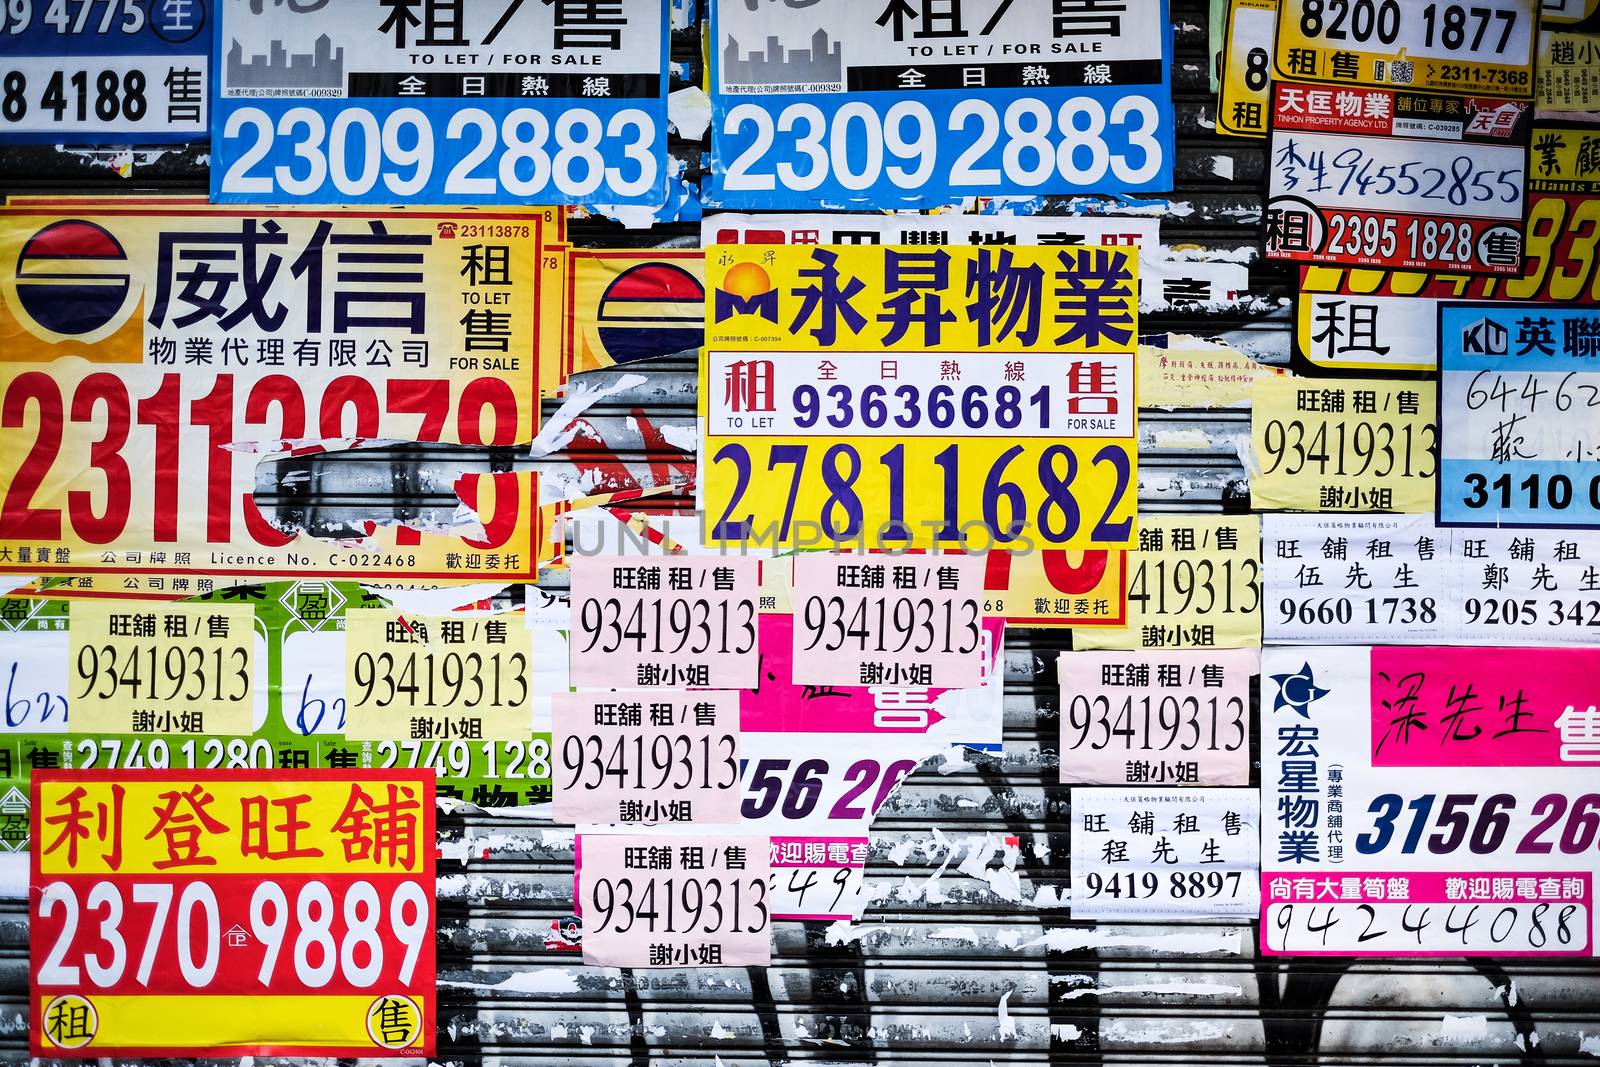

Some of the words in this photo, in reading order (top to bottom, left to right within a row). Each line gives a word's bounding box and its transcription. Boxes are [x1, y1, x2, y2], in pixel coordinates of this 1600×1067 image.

[45, 0, 146, 34] 4775
[1300, 0, 1400, 45] 8200
[1423, 4, 1517, 54] 1877
[409, 54, 434, 66] TO
[444, 54, 480, 66] LET
[503, 54, 542, 66] FOR
[551, 54, 603, 66] SALE
[907, 46, 934, 58] TO
[944, 45, 977, 57] LET
[1002, 43, 1041, 55] FOR
[1051, 42, 1103, 55] SALE
[1288, 48, 1317, 76] 租
[1331, 51, 1360, 79] 售
[398, 75, 611, 97] 全日熱線
[897, 64, 1113, 89] 全日熱線
[1440, 65, 1529, 85] 2311-7368
[41, 69, 147, 122] 4188
[163, 66, 202, 124] 售
[1397, 97, 1461, 115] 舖位專家
[1232, 101, 1262, 129] 租
[1278, 115, 1302, 123] TINHON
[1303, 116, 1342, 126] PROPERTY
[1343, 119, 1373, 128] AGENCY
[221, 107, 434, 196] 2309
[444, 107, 658, 197] 2883
[722, 100, 938, 192] 2309
[949, 95, 1164, 186] 2883
[461, 225, 530, 241] 23113878
[1328, 213, 1398, 257] 2395
[1405, 218, 1473, 263] 1828
[1482, 231, 1520, 265] 售
[148, 218, 433, 334] 威信
[460, 243, 513, 286] 租
[462, 292, 480, 305] TO
[485, 292, 511, 305] LET
[788, 248, 1134, 348] 永昇物業
[460, 309, 513, 353] 售
[1311, 300, 1391, 359] 租
[1515, 316, 1600, 358] 英聯
[148, 337, 429, 367] 物業代理有限公司
[449, 358, 479, 371] FOR
[482, 358, 520, 371] SALE
[818, 360, 1024, 382] 全日熱線
[723, 359, 778, 413] 租
[1066, 361, 1119, 415] 售
[793, 384, 1051, 429] 93636681
[1297, 389, 1345, 413] 旺舖
[727, 417, 743, 429] TO
[751, 417, 774, 429] LET
[1067, 419, 1088, 430] FOR
[1090, 419, 1116, 430] SALE
[1264, 419, 1437, 478] 93419313
[711, 442, 1133, 543] 27811682
[1319, 486, 1393, 509] 謝小姐
[1463, 473, 1574, 510] 3110
[0, 545, 71, 565] 大量實盤
[101, 550, 193, 566] 公司牌照
[210, 551, 276, 566] Licence
[287, 554, 317, 567] No.
[329, 553, 417, 567] C-022468
[445, 552, 521, 570] 歡迎委托
[1277, 536, 1435, 562] 旺舖租售
[1463, 537, 1582, 563] 旺舖租
[614, 566, 661, 591] 旺舖
[837, 565, 885, 590] 旺舖
[1294, 562, 1420, 590] 伍先生
[1481, 563, 1600, 593] 鄭先生
[1034, 597, 1109, 616] 歡迎委托
[1279, 597, 1353, 625] 9660
[1364, 597, 1438, 625] 1738
[1464, 598, 1539, 626] 9205
[109, 613, 158, 638] 旺舖
[581, 597, 756, 655] 93419313
[803, 595, 979, 655] 93419313
[1142, 625, 1216, 648] 謝小姐
[77, 644, 251, 702] 93419313
[354, 651, 528, 708] 93419313
[637, 663, 711, 687] 謝小姐
[860, 662, 934, 686] 謝小姐
[1102, 663, 1150, 688] 旺舖
[131, 709, 205, 733] 謝小姐
[411, 716, 484, 740] 謝小姐
[594, 702, 642, 727] 旺舖
[1069, 694, 1246, 753] 93419313
[563, 734, 738, 791] 93419313
[1126, 760, 1200, 784] 謝小姐
[1277, 723, 1321, 865] 宏星物業
[620, 799, 693, 823] 謝小姐
[1084, 810, 1243, 837] 旺舖租售
[1355, 793, 1517, 855] 3156
[42, 782, 422, 873] 利登旺舖
[624, 845, 672, 871] 旺舖
[1101, 836, 1226, 865] 程先生
[1086, 871, 1159, 899] 9419
[1169, 871, 1243, 899] 8897
[1268, 876, 1412, 901] 尚有大量筍盤
[1444, 876, 1585, 901] 歡迎賜電查詢
[593, 877, 769, 934] 93419313
[38, 880, 221, 988] 2370
[249, 880, 429, 988] 9889
[1277, 903, 1577, 952] 94244088
[649, 943, 723, 966] 謝小姐
[48, 1000, 93, 1044] 租
[372, 997, 413, 1044] 售
